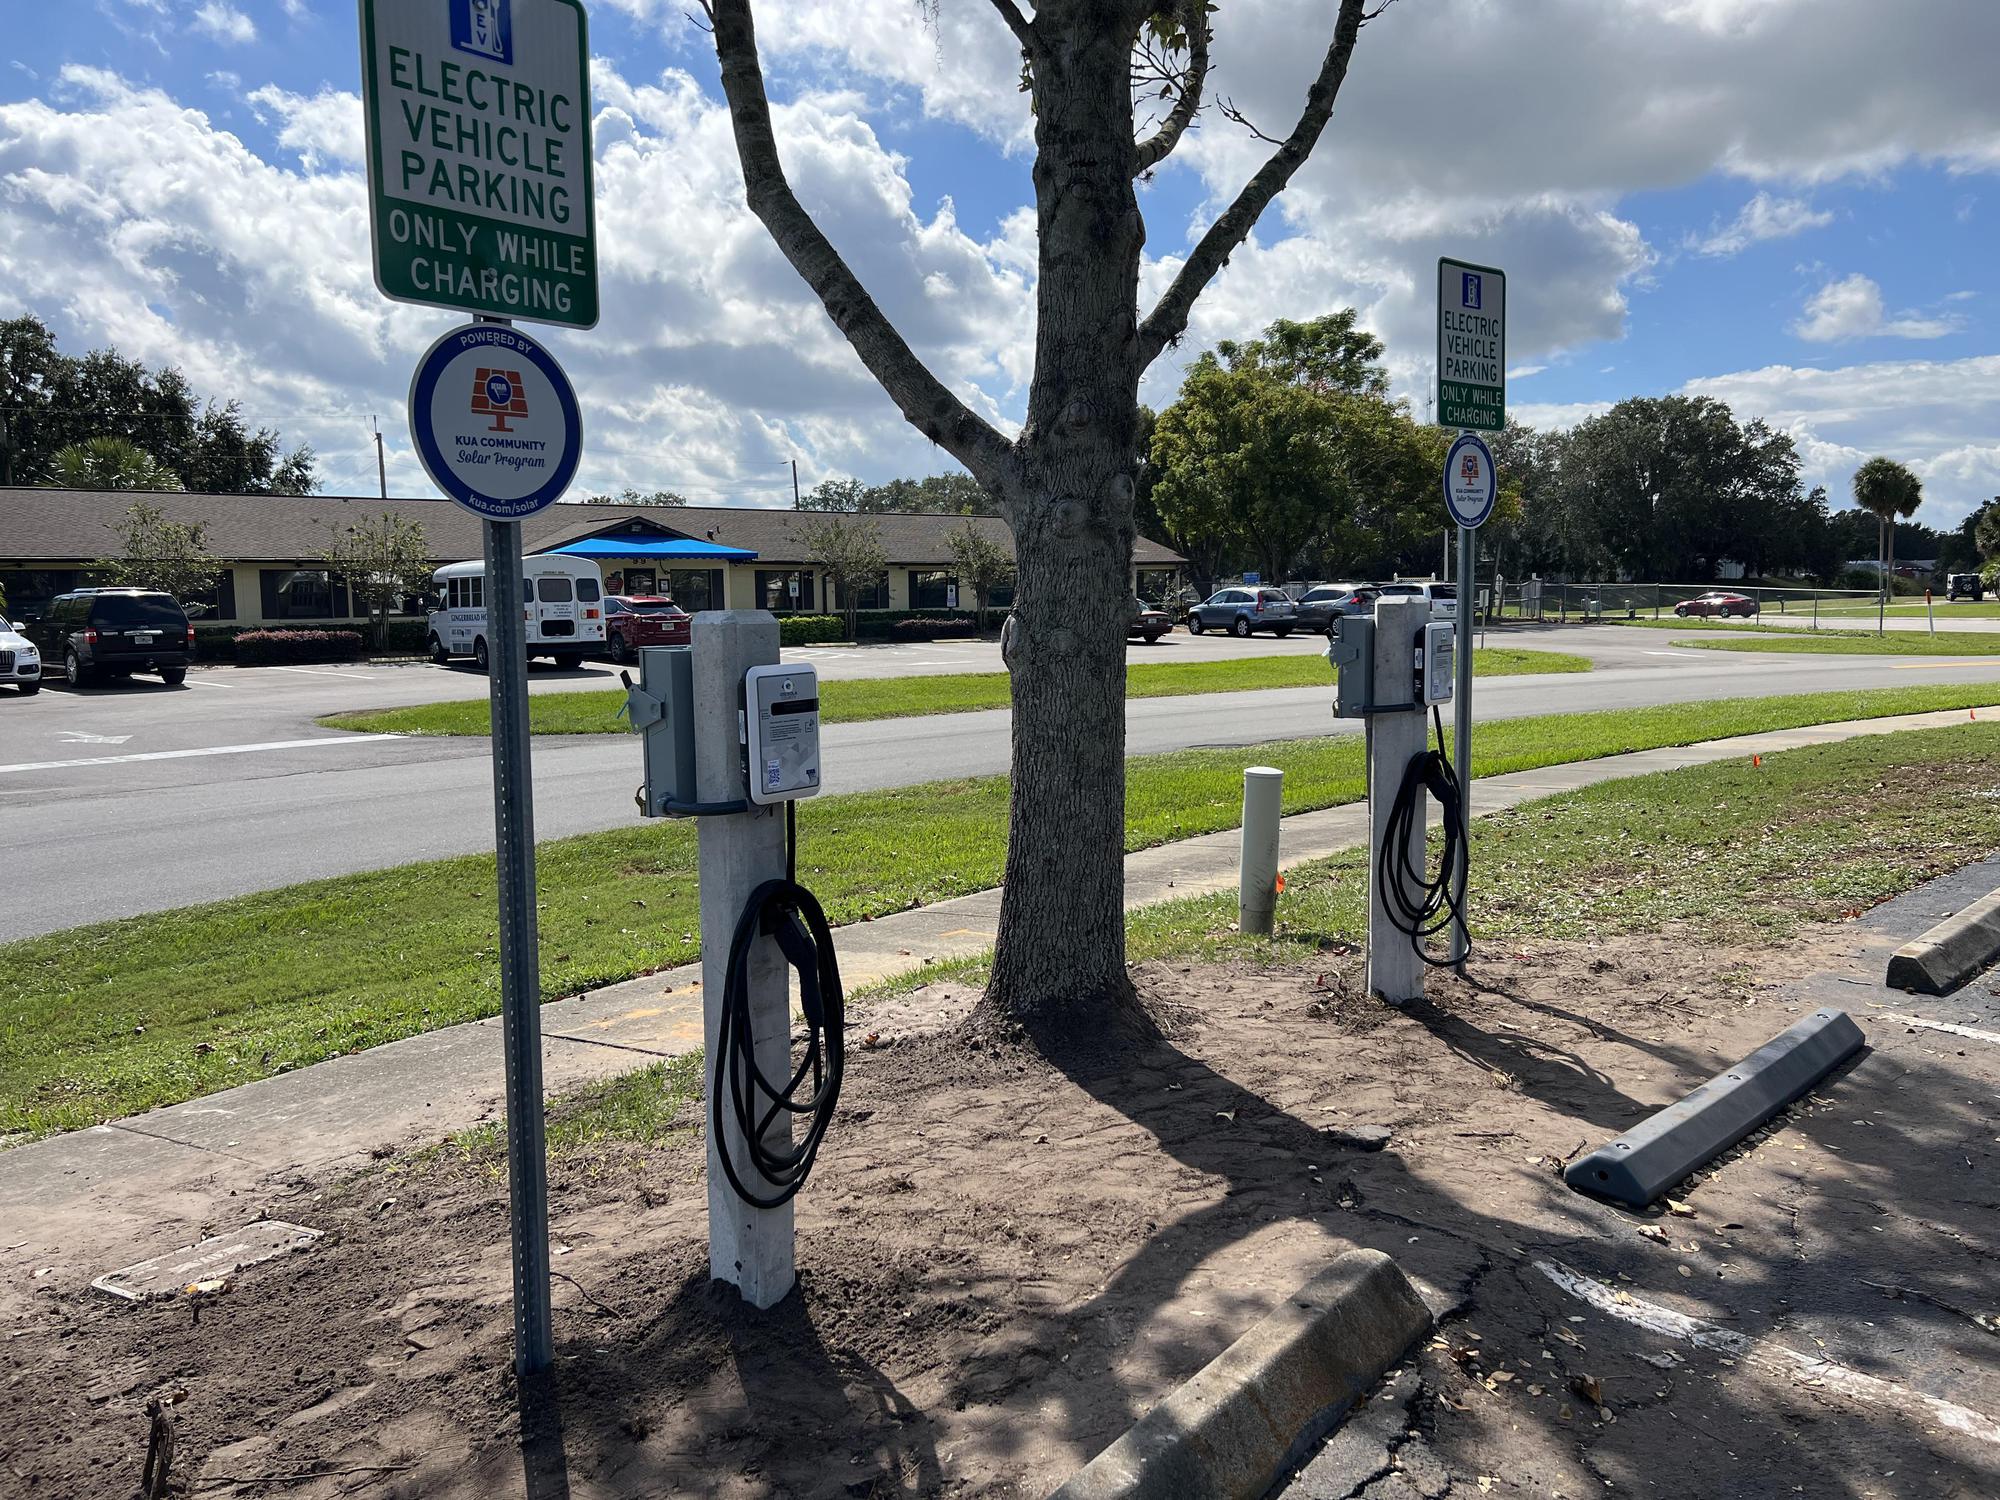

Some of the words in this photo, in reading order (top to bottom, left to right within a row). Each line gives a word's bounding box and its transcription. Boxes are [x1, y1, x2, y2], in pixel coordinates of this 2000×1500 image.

[389, 45, 571, 133] ELECTRIC
[401, 99, 566, 178] VEHICLE
[401, 150, 570, 224] PARKING
[389, 208, 479, 256] ONLY
[496, 230, 587, 277] WHILE
[411, 257, 571, 312] CHARGING
[1444, 310, 1499, 338] ELECTRIC
[459, 331, 515, 347] POWERED
[517, 341, 533, 354] BY
[1447, 334, 1497, 360] VEHICLE
[1446, 357, 1497, 383] PARKING
[1441, 384, 1468, 403] ONLY
[1472, 388, 1502, 407] WHILE
[1446, 406, 1497, 426] CHARGING
[455, 435, 478, 447] KUA
[480, 437, 546, 451] COMMUNITY
[456, 450, 491, 465] Solar
[493, 452, 545, 471] Program
[468, 493, 539, 515] kua.com/solar
